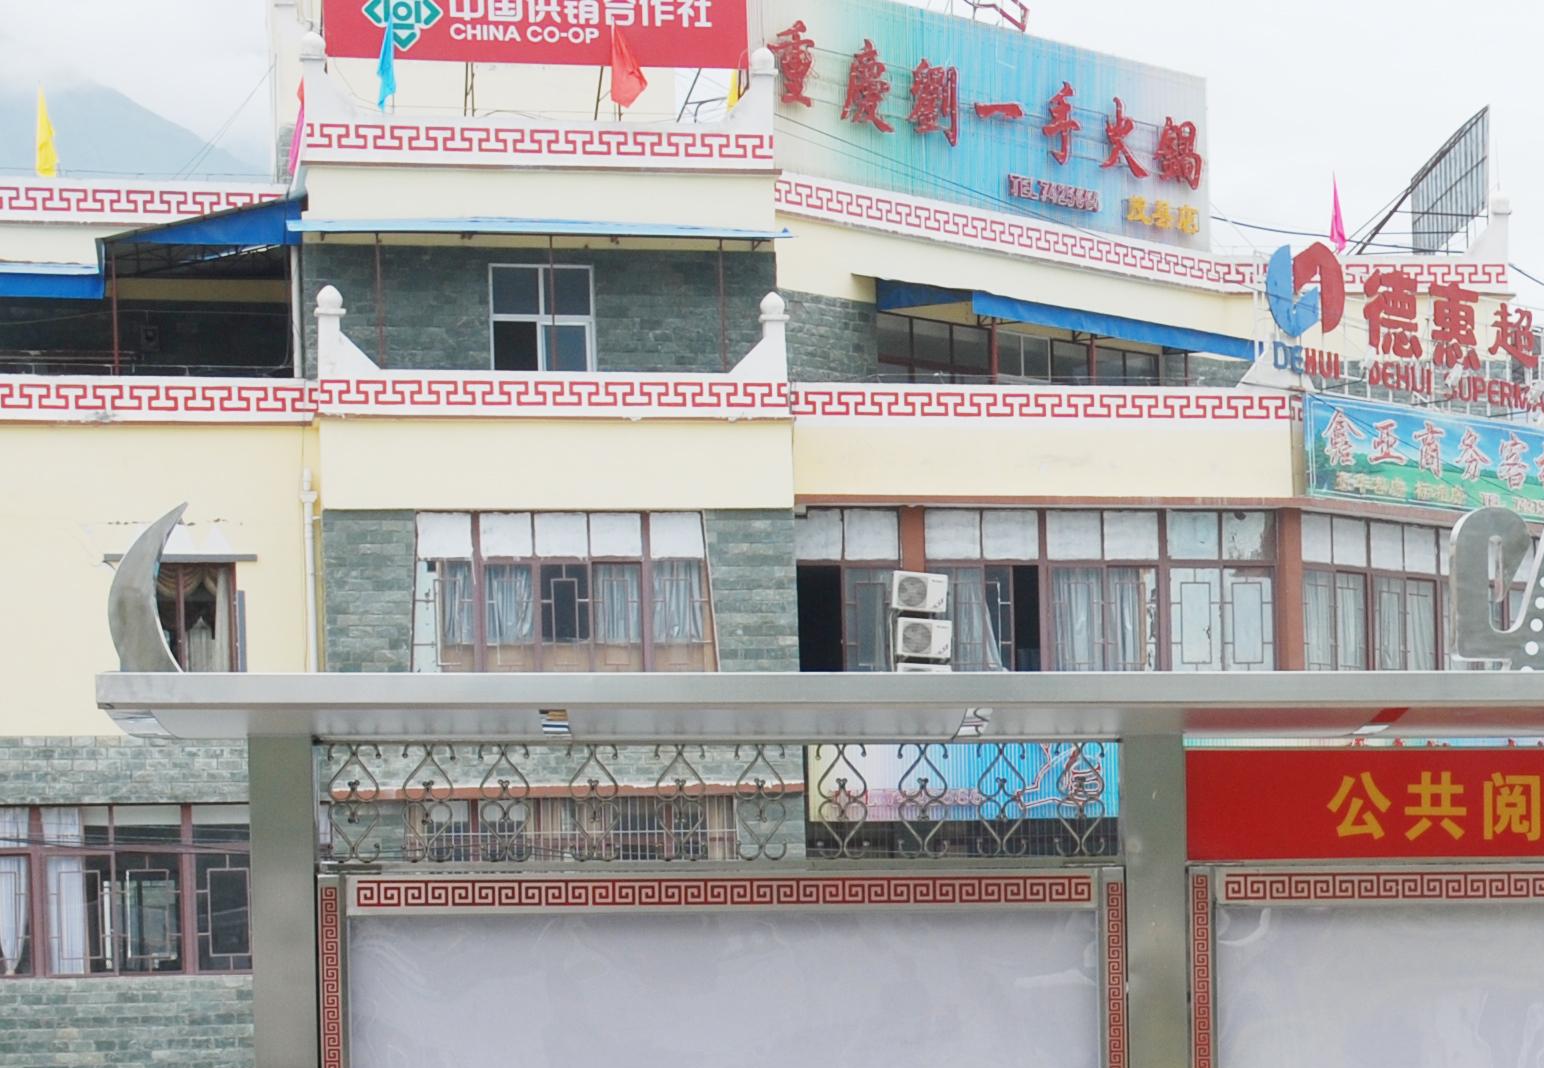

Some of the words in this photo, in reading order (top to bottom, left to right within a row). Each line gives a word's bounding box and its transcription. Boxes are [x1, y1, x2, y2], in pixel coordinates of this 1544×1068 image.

[449, 23, 521, 43] CHINA
[526, 25, 600, 45] CO-OP
[1272, 340, 1341, 379] DEHUI
[1368, 360, 1433, 396] DEHUI
